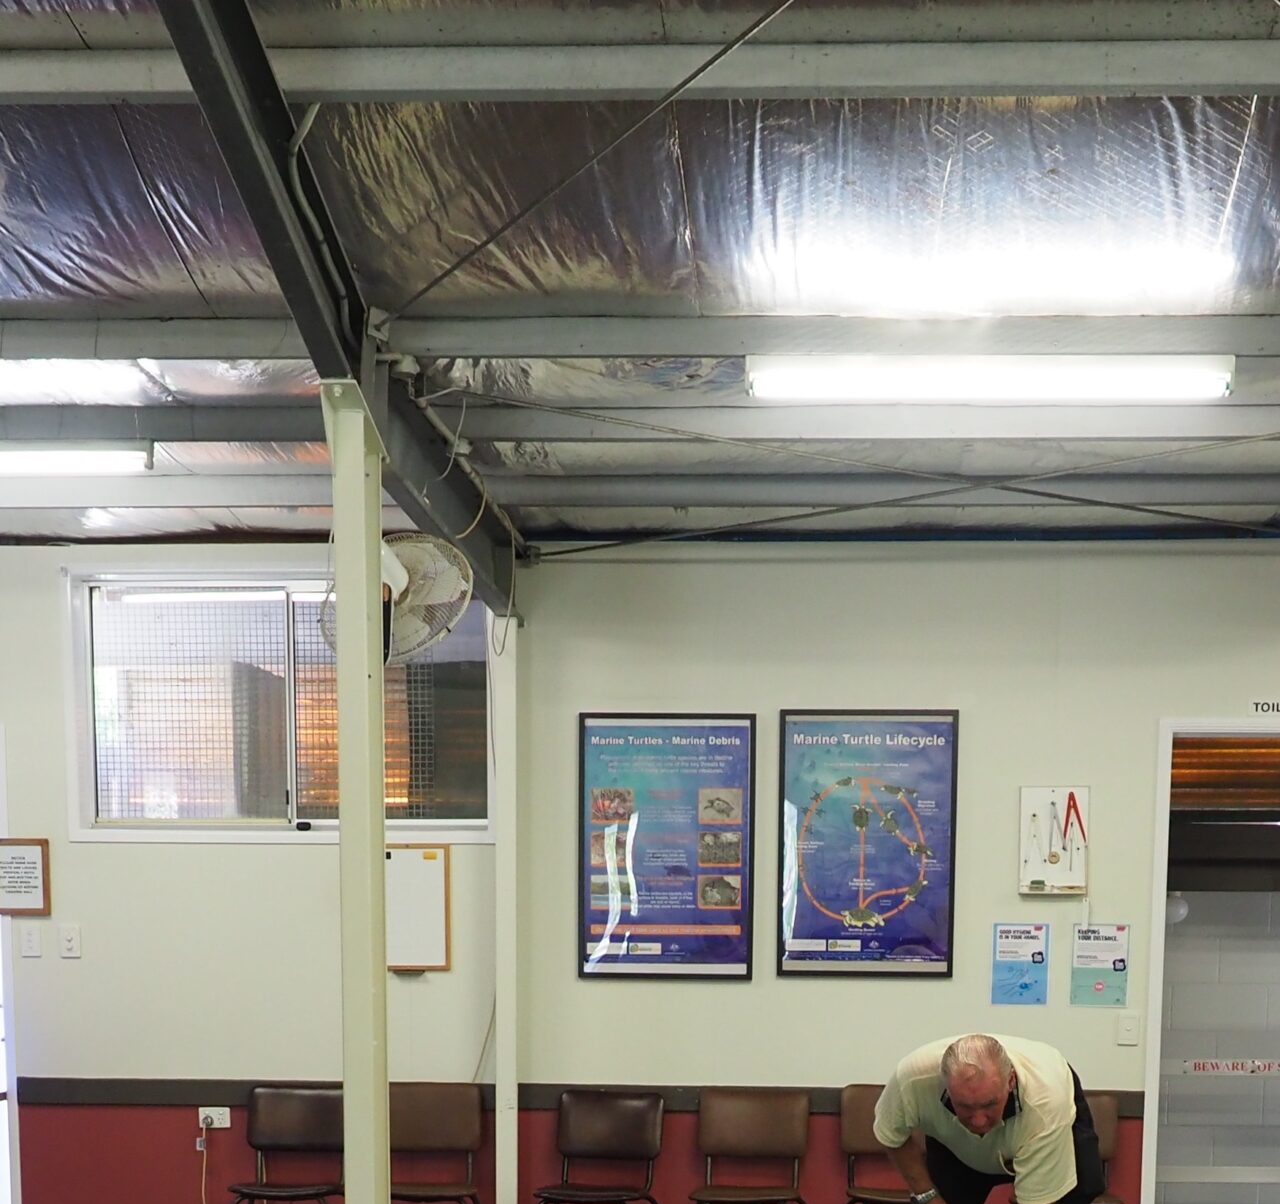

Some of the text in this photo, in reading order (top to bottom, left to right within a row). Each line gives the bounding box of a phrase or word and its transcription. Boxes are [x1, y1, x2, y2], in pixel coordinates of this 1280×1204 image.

[591, 736, 625, 745] Marine
[628, 736, 663, 745] Turtles
[672, 736, 706, 745] Marine
[709, 736, 741, 745] Debris
[793, 734, 946, 748] Marine Turtle Lifecycle
[1193, 1061, 1249, 1072] BEWARE
[1256, 1061, 1274, 1072] OF
